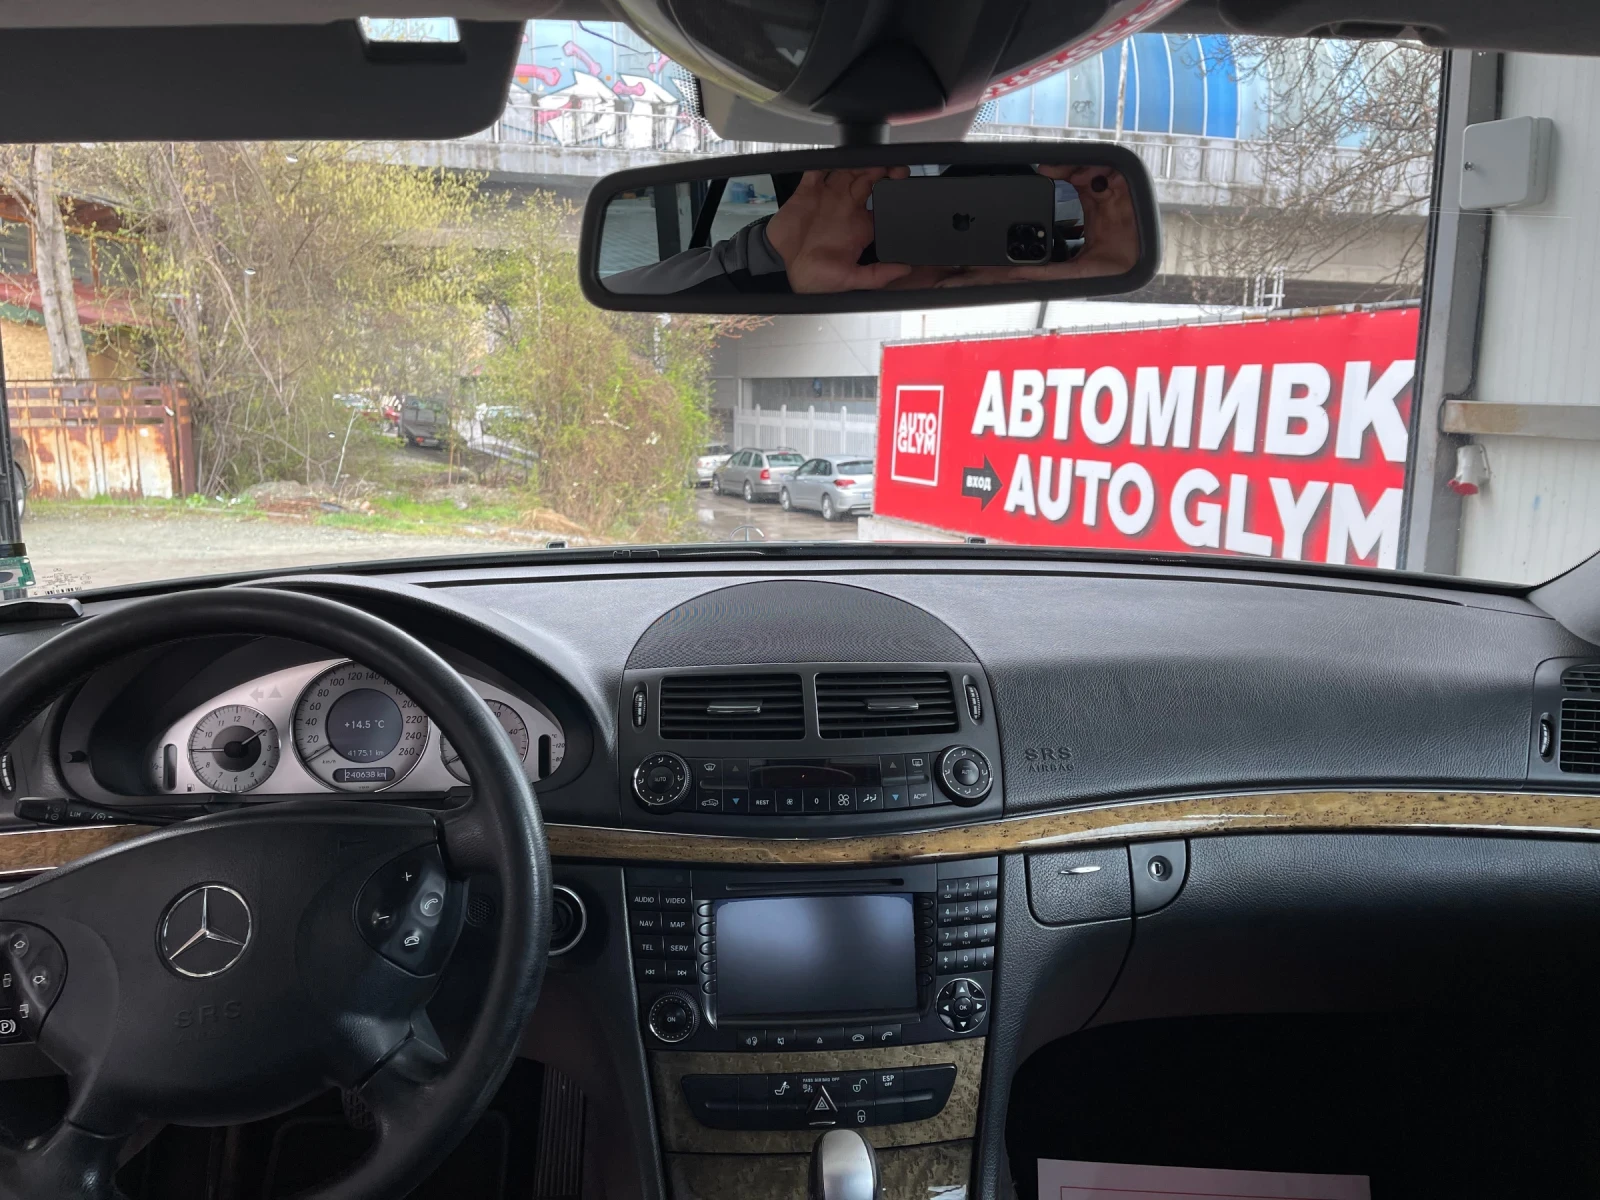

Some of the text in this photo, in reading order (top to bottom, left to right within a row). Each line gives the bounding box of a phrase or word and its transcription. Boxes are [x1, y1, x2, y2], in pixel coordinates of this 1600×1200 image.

[971, 360, 1416, 462] АВТОМИВК
[898, 411, 937, 434] AUTO
[897, 432, 936, 456] GLYM
[966, 475, 992, 491] ВХОД
[1003, 454, 1404, 570] AUTO GLYM
[347, 672, 362, 680] 120
[365, 672, 381, 680] 140
[329, 678, 344, 687] 100
[317, 689, 329, 697] 80
[309, 702, 322, 711] 60
[305, 718, 318, 726] 40
[405, 716, 423, 724] 220
[344, 720, 371, 729] +14.5
[306, 735, 319, 743] 20
[405, 732, 421, 740] 240
[398, 747, 415, 756] 260
[1025, 746, 1073, 761] SRS
[1028, 763, 1075, 773] AIRBAG
[345, 771, 376, 779] 240638
[642, 943, 653, 951] TEL
[959, 1003, 967, 1011] OK
[174, 1000, 241, 1028] SRS
[667, 1015, 676, 1023] ON
[882, 1074, 895, 1082] ESP
